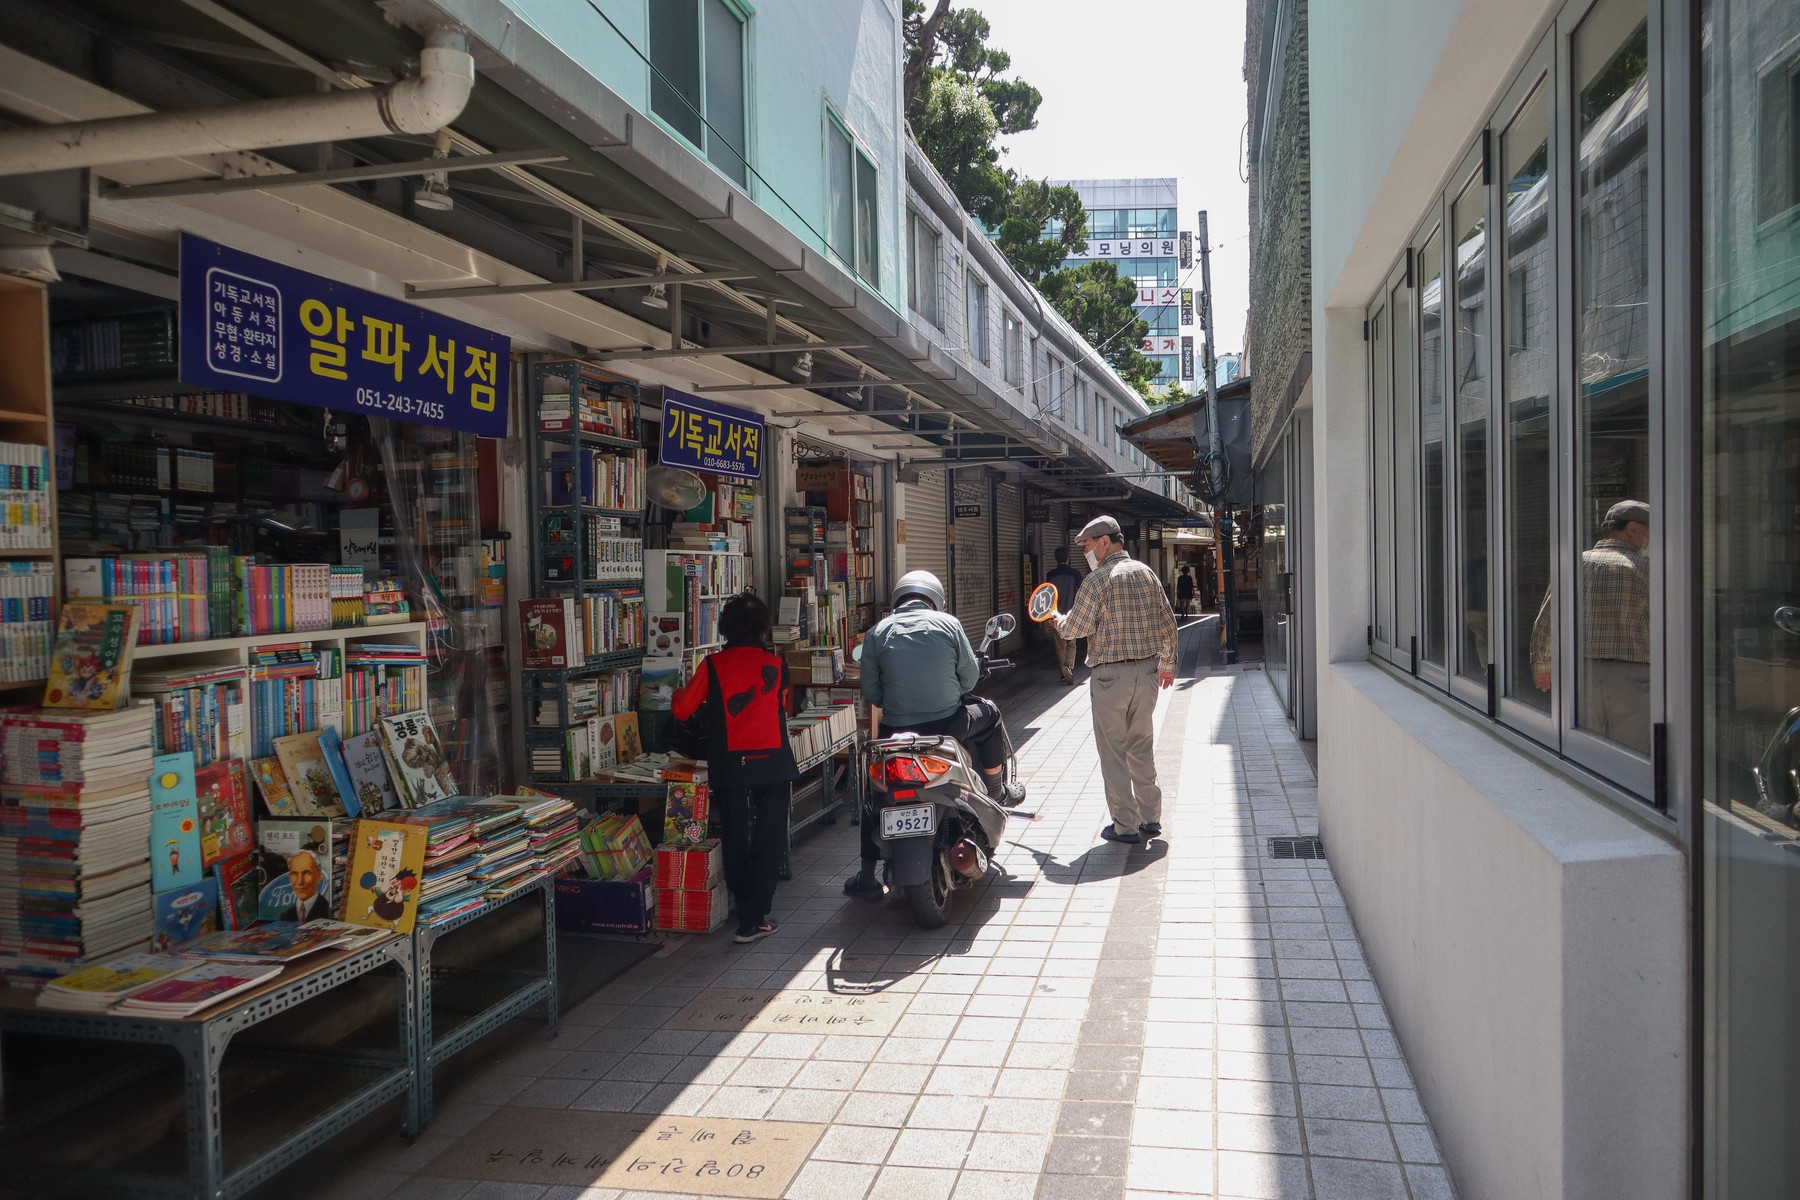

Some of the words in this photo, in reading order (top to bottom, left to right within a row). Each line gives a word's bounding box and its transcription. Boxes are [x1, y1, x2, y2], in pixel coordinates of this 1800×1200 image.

[213, 280, 276, 313] 기독교서적
[300, 298, 498, 412] 알파서점
[356, 386, 445, 420] 051-243-7455
[668, 408, 759, 469] 기독교서적
[704, 456, 745, 472] 010-6683-5576
[393, 719, 418, 738] 공룡
[896, 816, 929, 832] 9527
[772, 1014, 875, 1026] 수레바퀴
